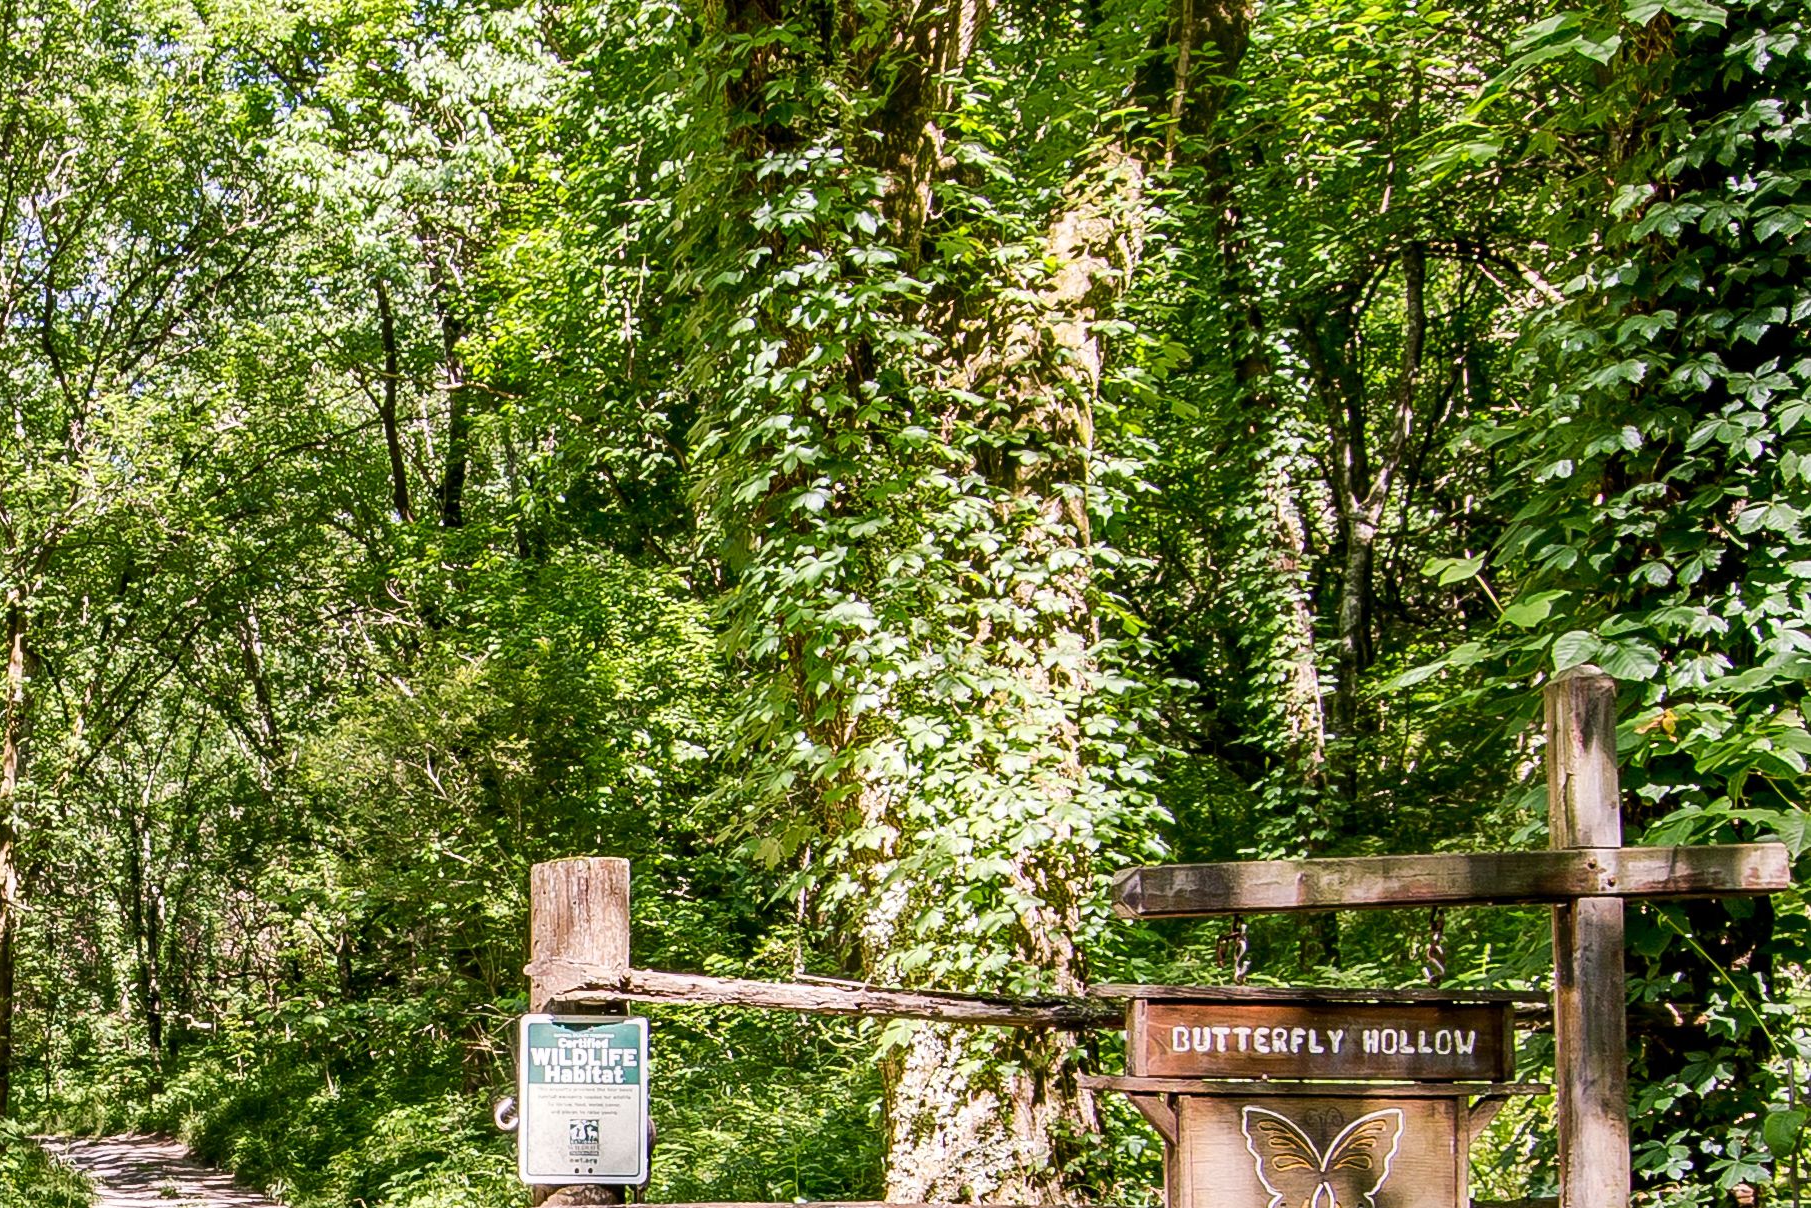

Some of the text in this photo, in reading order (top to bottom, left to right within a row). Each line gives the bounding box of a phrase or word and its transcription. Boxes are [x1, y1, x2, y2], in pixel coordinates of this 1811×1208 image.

[557, 1037, 609, 1049] Certified
[1171, 1025, 1476, 1056] BUTTERFLY HOLLOW
[530, 1048, 638, 1067] WILDLIFE
[544, 1064, 624, 1084] Habitat
